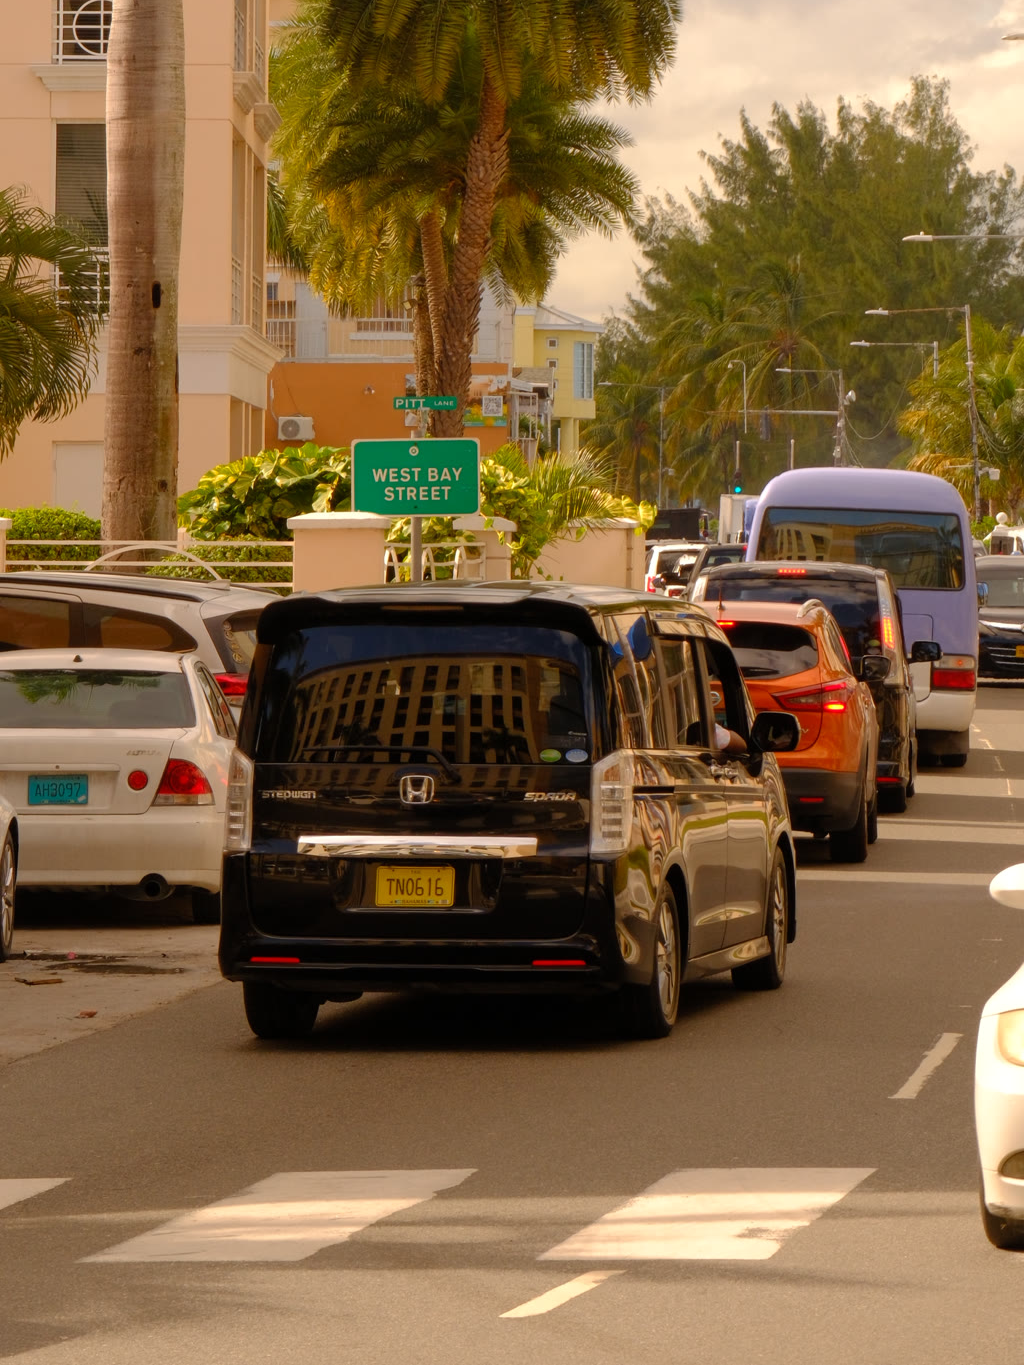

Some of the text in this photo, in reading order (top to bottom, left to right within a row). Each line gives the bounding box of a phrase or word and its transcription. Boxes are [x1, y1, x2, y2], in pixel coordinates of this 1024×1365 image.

[395, 398, 426, 409] PITT
[372, 466, 463, 483] WEST BAY
[384, 486, 452, 501] STREET
[34, 782, 81, 798] AH3097
[261, 789, 317, 800] STEPWGN
[522, 791, 577, 802] SPADA
[386, 877, 444, 897] TN0616
